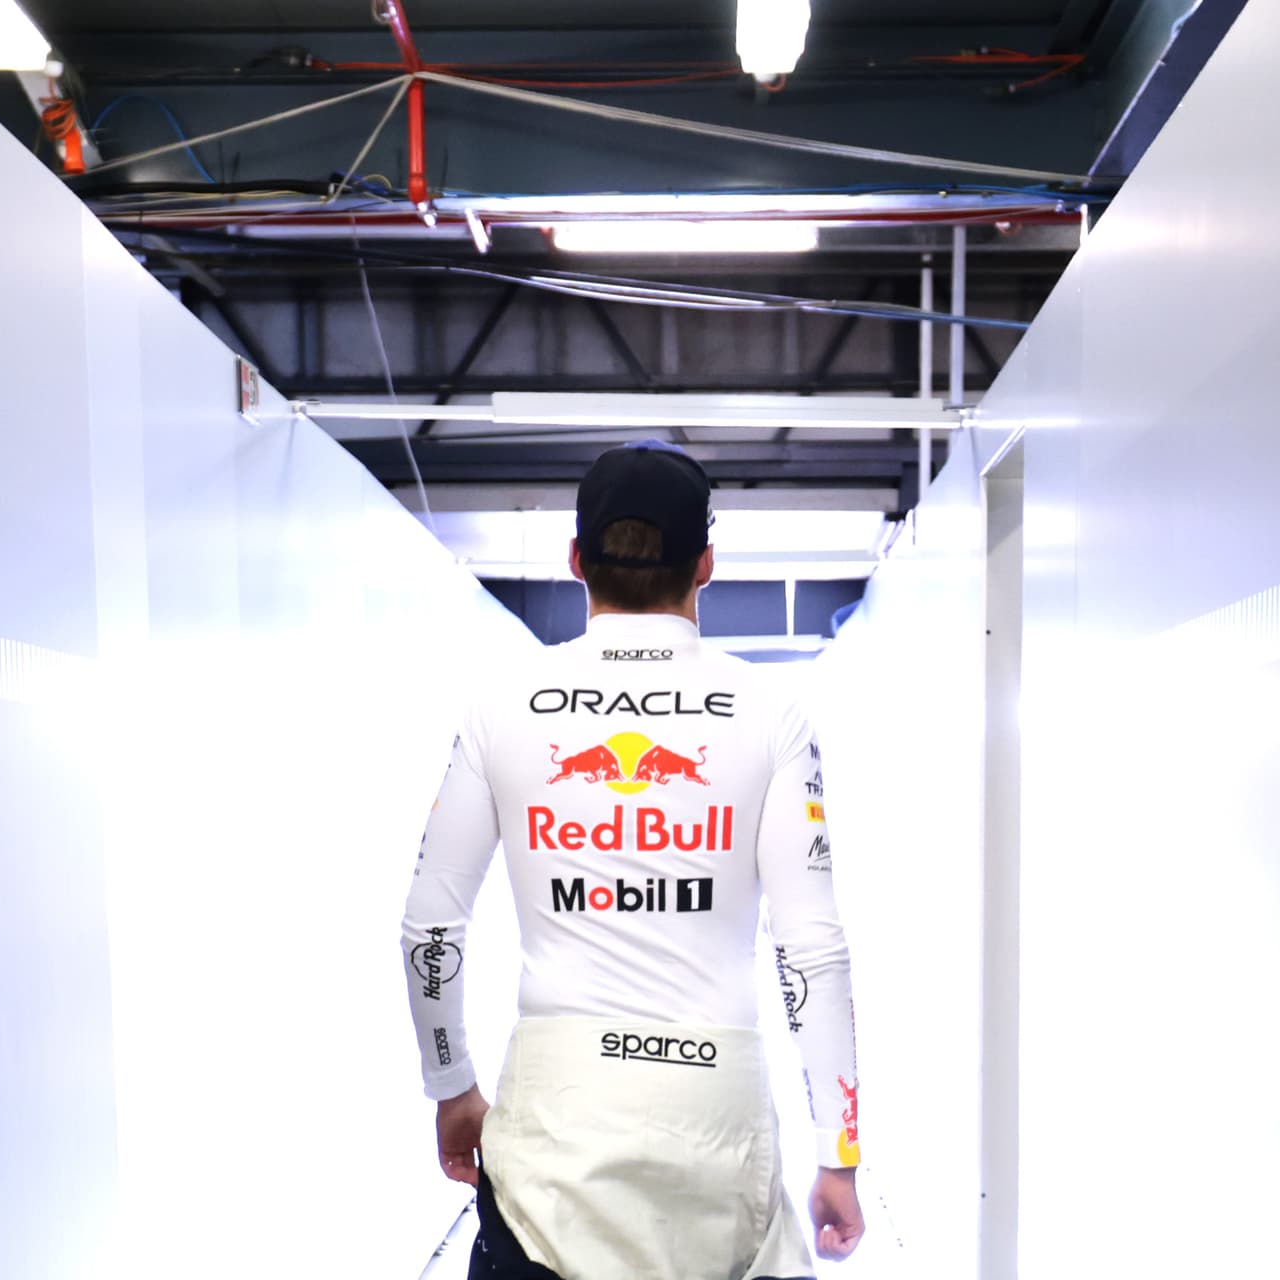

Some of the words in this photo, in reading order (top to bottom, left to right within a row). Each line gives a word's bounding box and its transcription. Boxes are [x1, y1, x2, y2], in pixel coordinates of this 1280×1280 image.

[602, 649, 673, 660] sparco
[529, 688, 735, 717] ORACLE
[527, 804, 622, 851] Red
[636, 806, 733, 851] Bull
[551, 878, 666, 912] Mobil
[423, 926, 448, 962] Rock
[423, 959, 441, 1000] Hard
[782, 988, 803, 1033] Rock
[433, 1027, 452, 1066] sparco
[601, 1032, 717, 1067] sparco
